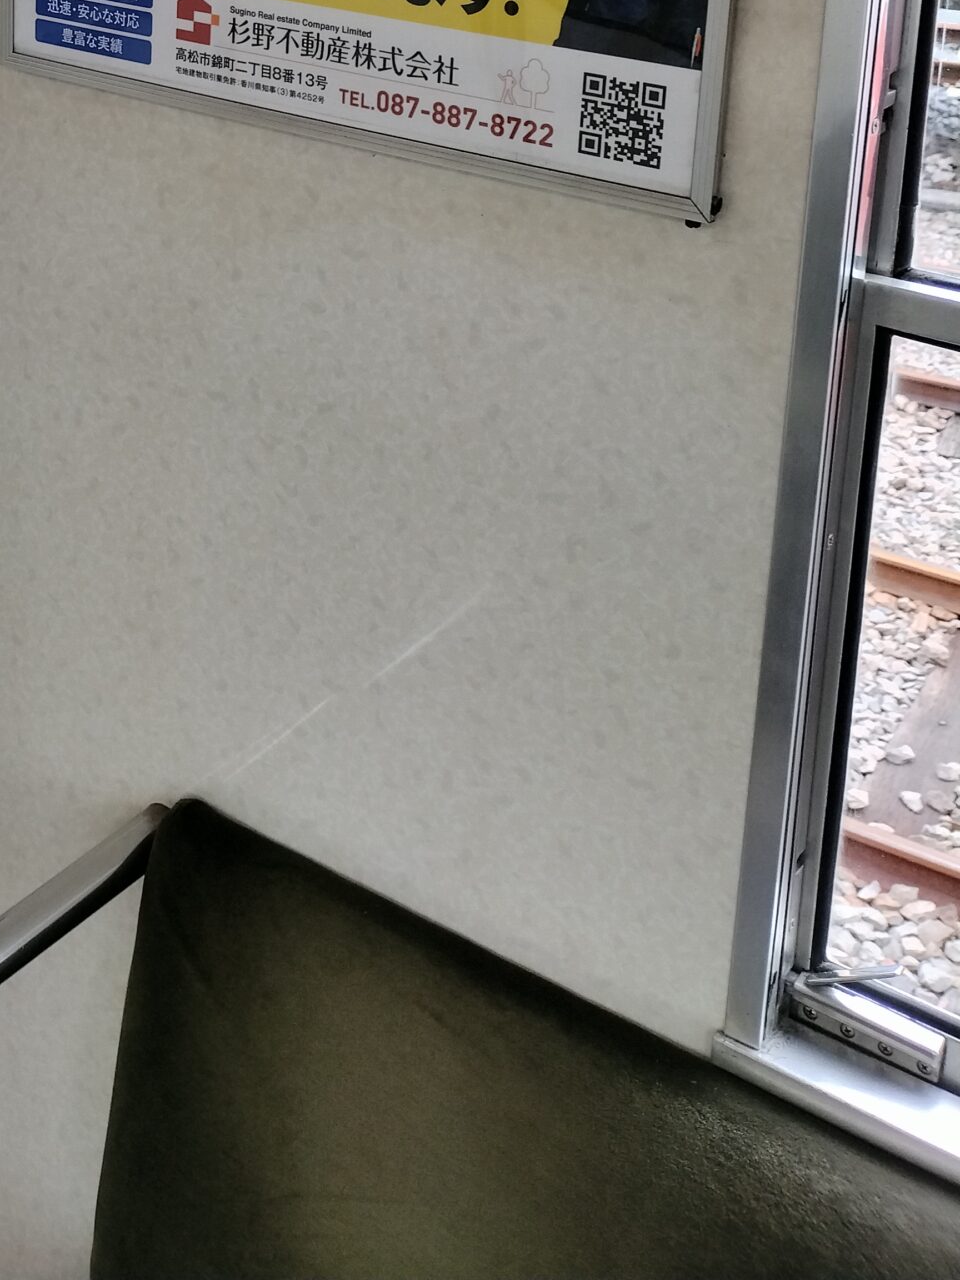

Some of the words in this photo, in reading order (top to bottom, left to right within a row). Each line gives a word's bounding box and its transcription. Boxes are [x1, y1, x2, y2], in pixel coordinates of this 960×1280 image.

[62, 28, 123, 55] 豊富な実績
[229, 6, 257, 19] Sugino
[258, 10, 275, 21] Real
[276, 14, 301, 26] estate
[302, 18, 340, 34] Company
[341, 26, 372, 39] Limited
[175, 47, 328, 91] 高松市錦町二丁目8番13号
[227, 17, 460, 87] 杉野不動産株式会社
